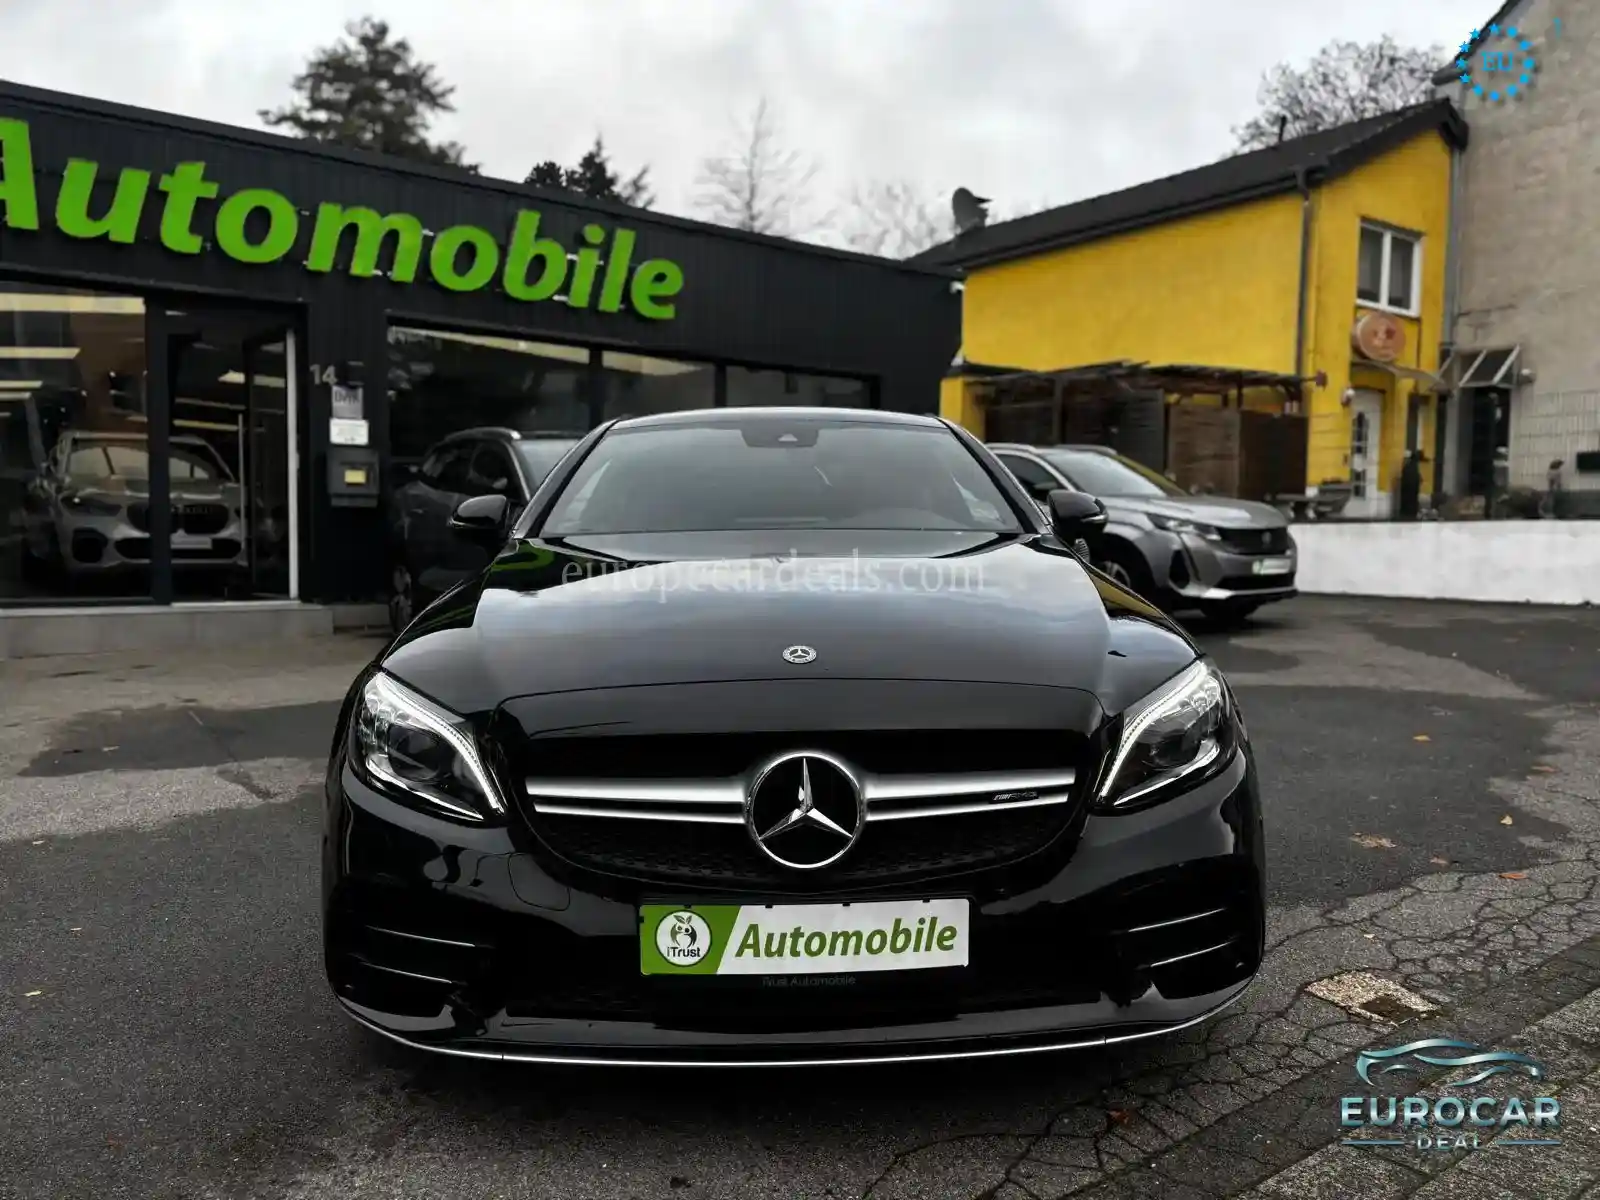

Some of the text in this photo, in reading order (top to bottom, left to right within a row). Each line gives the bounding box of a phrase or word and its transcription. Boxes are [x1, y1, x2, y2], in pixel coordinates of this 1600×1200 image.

[310, 364, 338, 385] 14
[667, 916, 957, 958] iTrust Automobile
